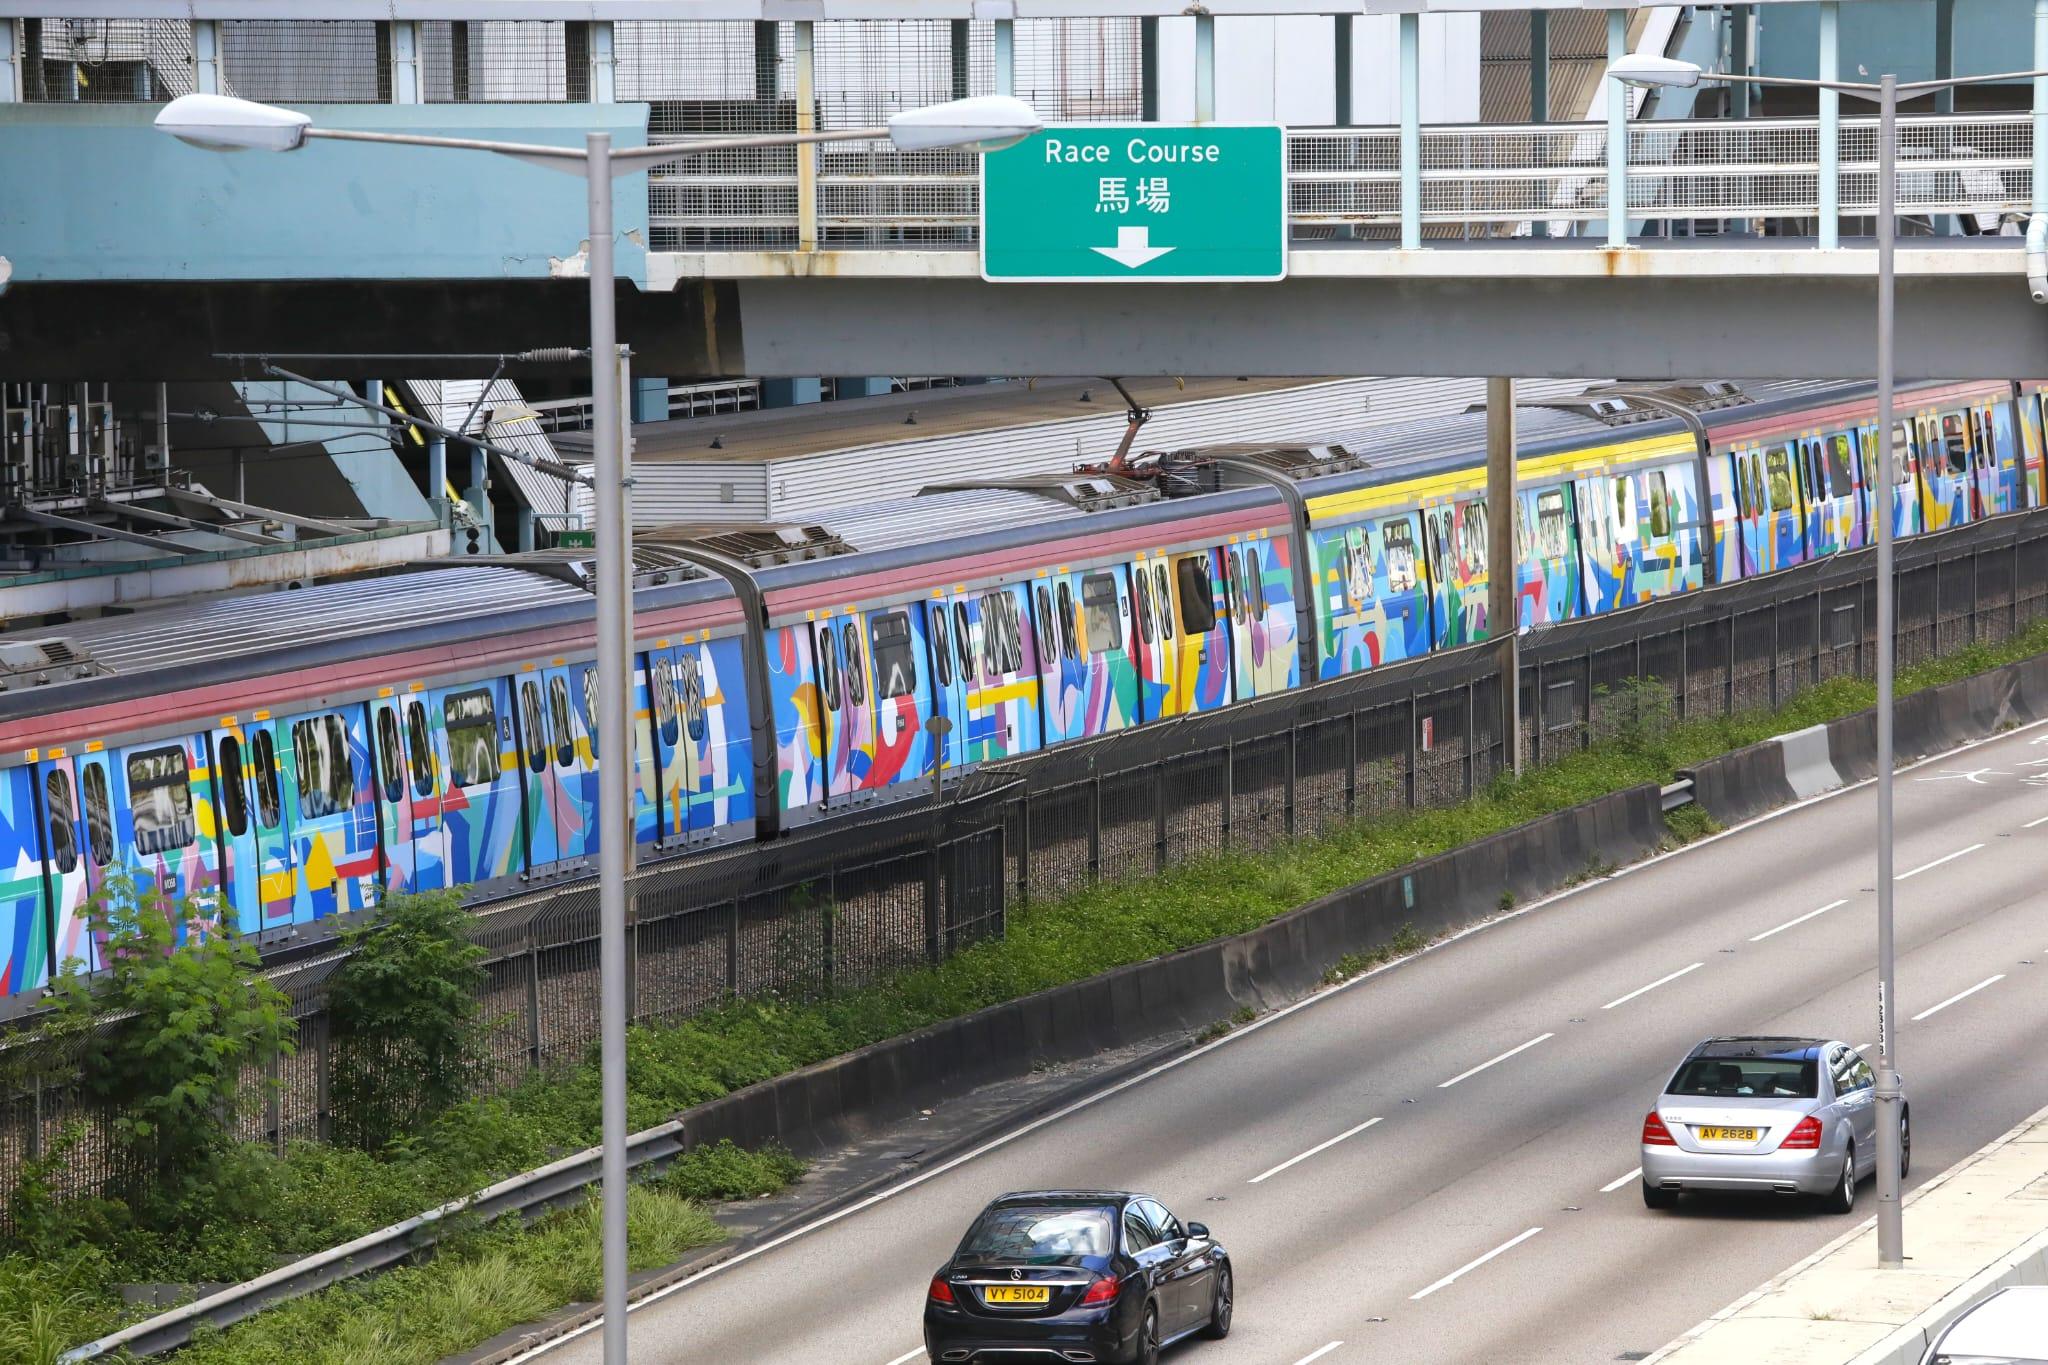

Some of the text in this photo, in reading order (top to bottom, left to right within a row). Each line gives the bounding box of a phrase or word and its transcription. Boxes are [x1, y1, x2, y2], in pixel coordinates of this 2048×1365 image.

[1045, 138, 1220, 163] Race Course
[1095, 177, 1171, 214] 馬場
[1702, 1128, 1754, 1139] AV 2628
[990, 1288, 1044, 1300] VY 5104
